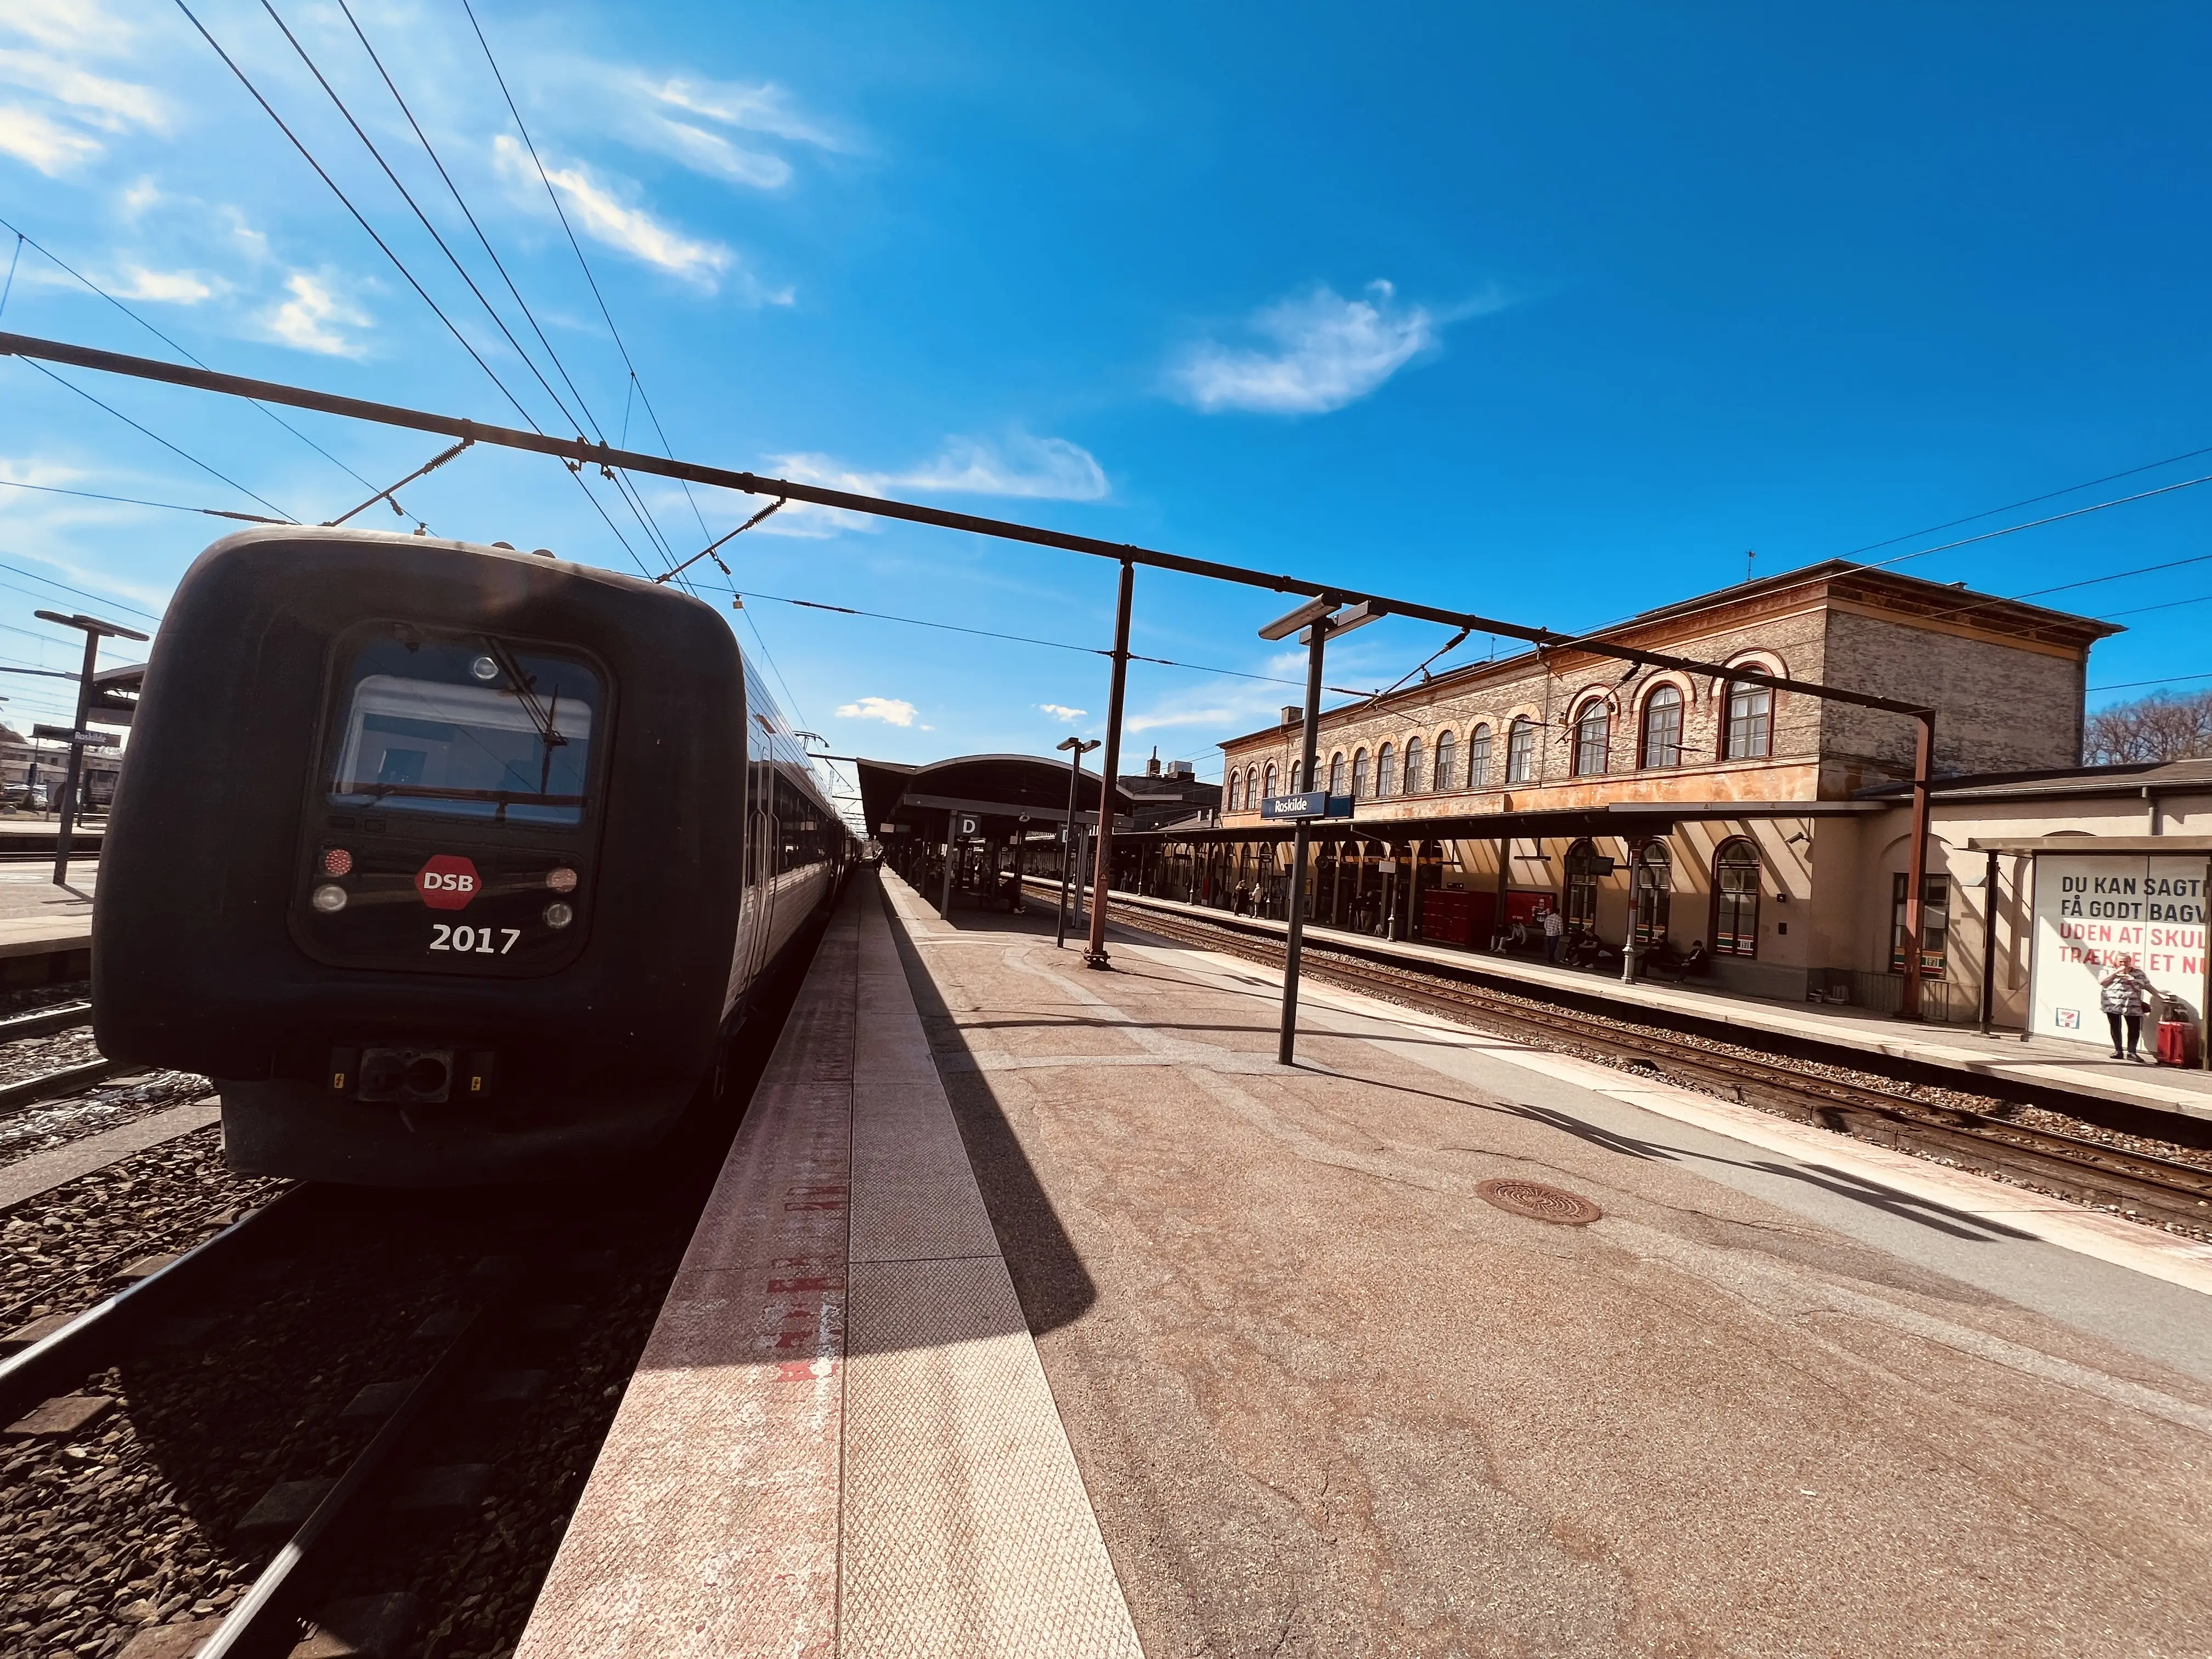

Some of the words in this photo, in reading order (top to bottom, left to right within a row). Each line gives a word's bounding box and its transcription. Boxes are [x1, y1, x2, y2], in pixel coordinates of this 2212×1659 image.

[75, 731, 106, 743] Roskilde
[1275, 797, 1307, 813] Roskilde
[963, 819, 975, 833] D
[423, 872, 473, 892] DSB
[2062, 877, 2087, 893] DU
[2095, 877, 2136, 895] KAN
[2061, 894, 2083, 916] FÅ
[2090, 901, 2142, 919] GODT
[430, 924, 521, 955] 2017
[2060, 923, 2111, 942] UDEN
[2119, 927, 2143, 944] AT
[2059, 946, 2142, 969] TRÆKE
[2150, 953, 2175, 972] ET
